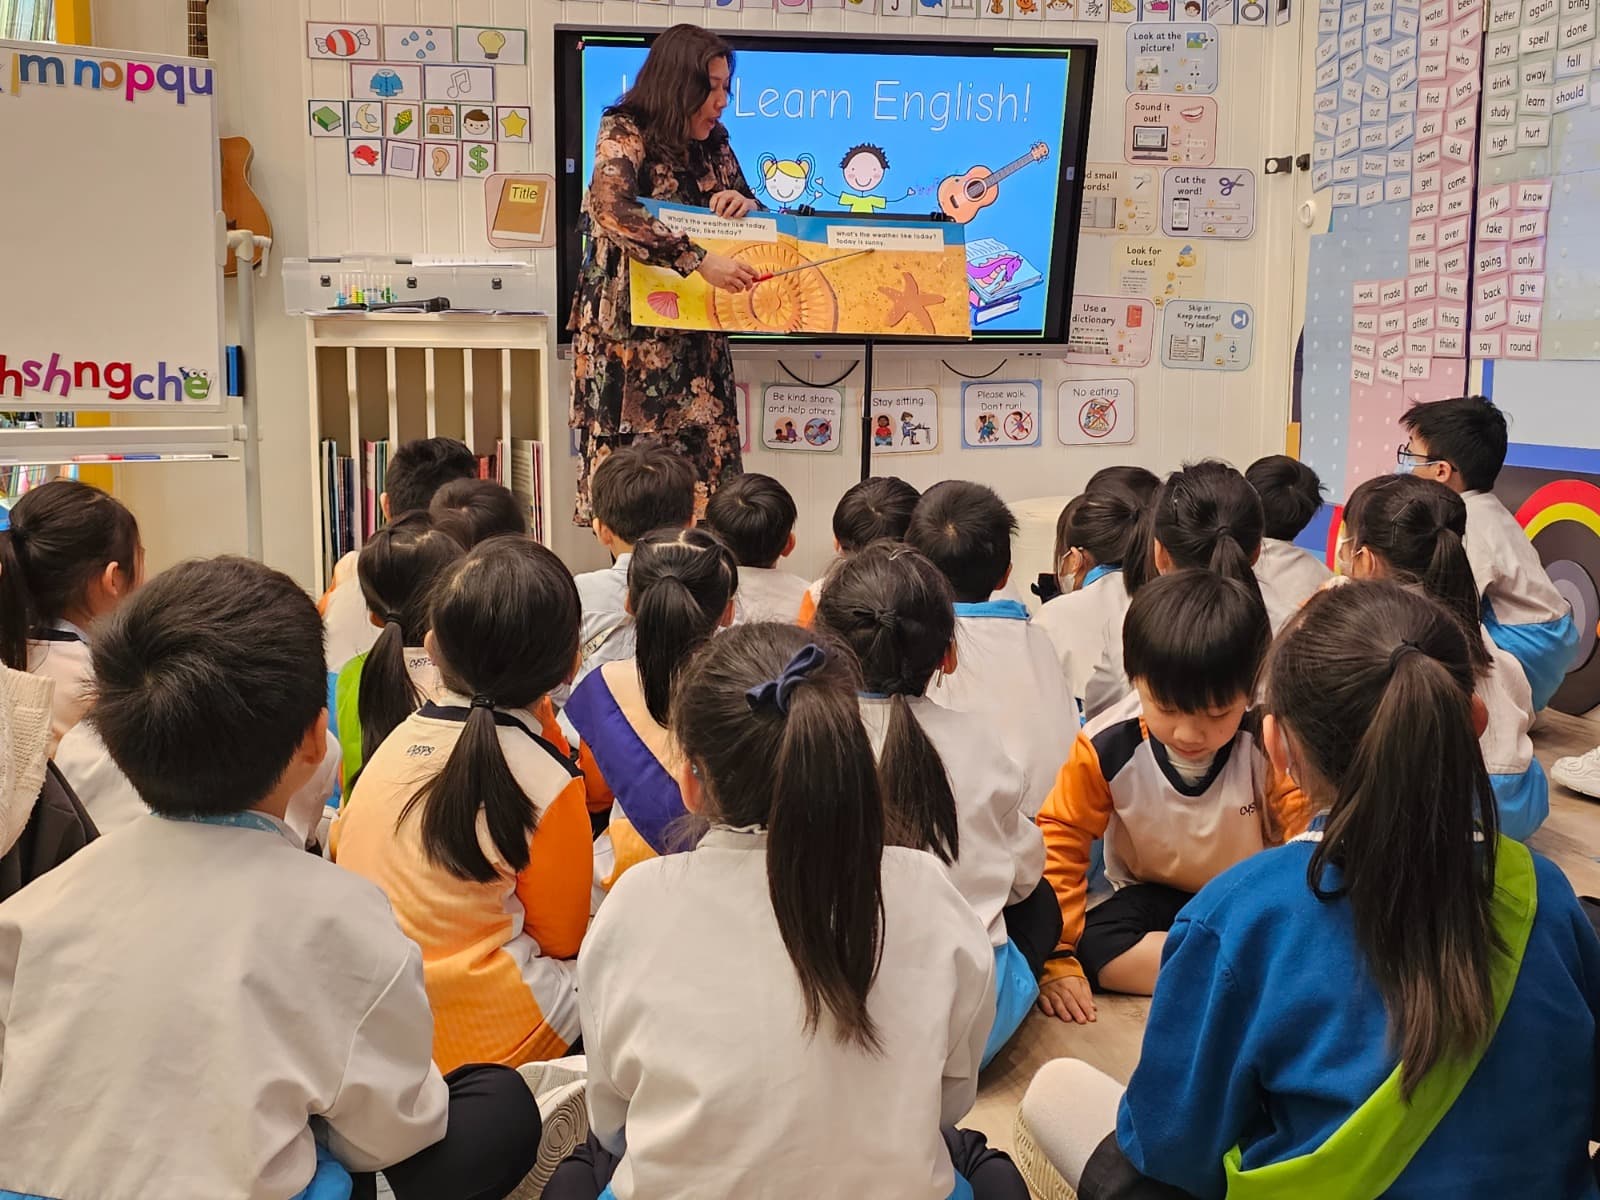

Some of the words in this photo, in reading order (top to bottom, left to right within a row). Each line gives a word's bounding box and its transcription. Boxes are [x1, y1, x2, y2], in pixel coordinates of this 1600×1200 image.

[1529, 0, 1553, 18] again
[1568, 0, 1590, 10] bring
[1425, 10, 1444, 22] water
[1494, 10, 1516, 23] better
[1134, 32, 1155, 40] Look
[1156, 32, 1165, 40] at
[1168, 32, 1181, 40] the
[1460, 28, 1470, 40] its
[1567, 23, 1588, 38] done
[1430, 37, 1439, 46] sit
[1528, 32, 1549, 48] spell
[1140, 43, 1175, 54] picture!
[1495, 43, 1511, 58] play
[1456, 55, 1470, 66] who
[1567, 54, 1581, 68] fall
[1426, 64, 1439, 73] now
[1526, 70, 1546, 82] away
[1492, 75, 1511, 90] drink
[1456, 81, 1472, 97] long
[1556, 85, 1584, 104] should
[735, 76, 852, 119] Learn
[873, 79, 1031, 132] English!
[1426, 93, 1439, 104] find
[1525, 95, 1545, 107] learn
[1135, 103, 1162, 111] Sound
[1164, 103, 1170, 111] it
[1490, 105, 1510, 120] study
[1422, 122, 1435, 135] day
[1454, 117, 1466, 129] yes
[1525, 127, 1540, 139] hurt
[1449, 143, 1462, 155] did
[1492, 137, 1508, 150] high
[1417, 150, 1436, 163] down
[1095, 170, 1118, 179] small
[1175, 176, 1192, 184] Cut
[1194, 175, 1206, 184] the
[1421, 178, 1433, 189] get
[1447, 176, 1466, 189] come
[512, 187, 537, 200] Title
[1178, 187, 1202, 195] word!
[1523, 190, 1542, 201] know
[1448, 200, 1462, 210] new
[1489, 197, 1499, 209] fly
[1415, 202, 1434, 216] place
[703, 220, 730, 228] weather
[1486, 223, 1503, 234] take
[1520, 222, 1537, 233] may
[1416, 233, 1426, 241] me
[1444, 229, 1459, 241] over
[1127, 246, 1146, 254] Look
[1149, 246, 1162, 255] for
[1131, 258, 1156, 266] clues!
[1415, 257, 1430, 268] little
[1444, 258, 1459, 271] year
[1480, 255, 1502, 271] going
[1518, 253, 1535, 267] only
[1414, 283, 1429, 295] part
[1445, 283, 1458, 294] live
[1483, 285, 1501, 300] back
[1520, 282, 1536, 295] give
[1358, 290, 1373, 299] work
[1384, 289, 1400, 301] made
[1083, 304, 1099, 313] Use
[1188, 304, 1202, 312] Skip
[1072, 316, 1116, 327] dictionary
[1177, 313, 1193, 321] Keep
[1194, 314, 1221, 322] reading!
[1442, 313, 1459, 327] thing
[1485, 311, 1497, 322] our
[1516, 310, 1531, 324] just
[1184, 321, 1194, 329] Try
[1358, 320, 1373, 330] most
[1385, 318, 1398, 329] very
[1412, 317, 1429, 329] after
[1354, 344, 1371, 354] name
[1411, 343, 1427, 352] man
[1440, 339, 1456, 349] think
[1480, 343, 1492, 353] say
[1510, 340, 1531, 352] round
[1382, 344, 1399, 358] good
[1354, 367, 1370, 379] great
[1381, 367, 1398, 379] where
[1409, 362, 1423, 374] help
[773, 392, 784, 400] Be
[810, 394, 834, 403] share
[977, 390, 1004, 398] Please
[1073, 388, 1086, 397] No
[872, 397, 892, 407] Stay
[981, 402, 1002, 411] Don't
[1005, 402, 1022, 410] run!
[768, 405, 784, 413] and
[788, 405, 806, 415] help
